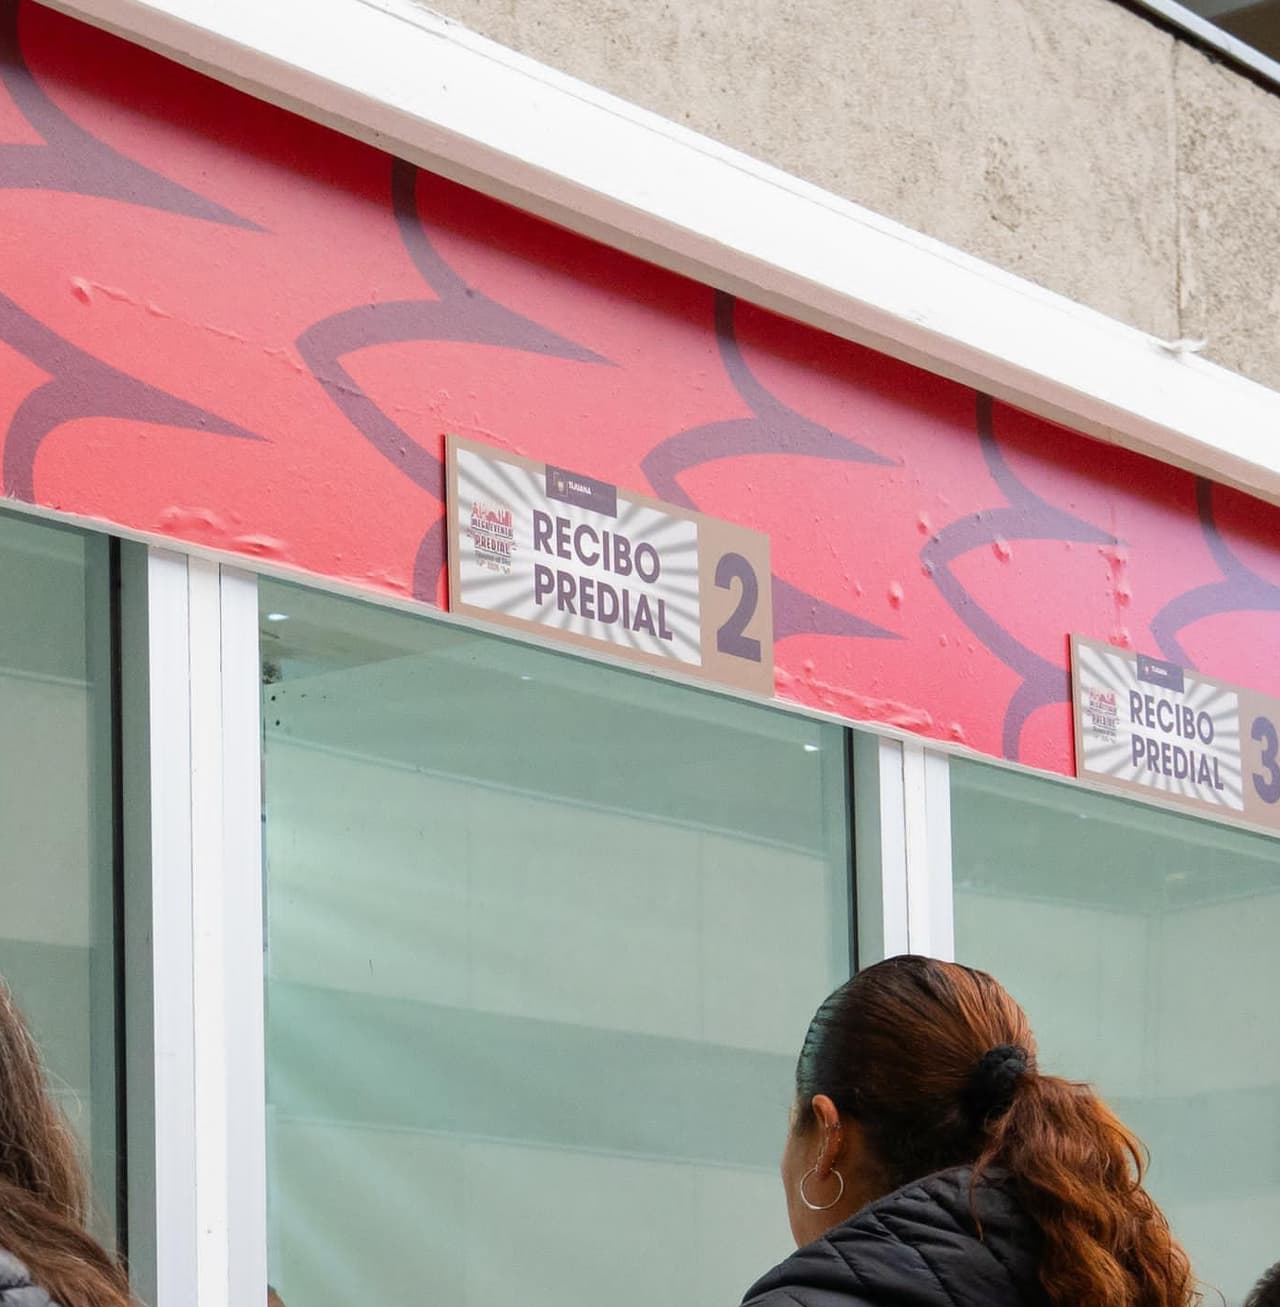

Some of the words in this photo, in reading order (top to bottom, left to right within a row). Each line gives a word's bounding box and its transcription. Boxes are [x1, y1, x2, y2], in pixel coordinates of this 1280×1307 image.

[533, 509, 661, 584] RECIBO
[534, 563, 673, 641] PREDIAL
[714, 552, 761, 663] 2
[1129, 690, 1215, 745] RECIBO
[1131, 734, 1224, 790] PREDIAL
